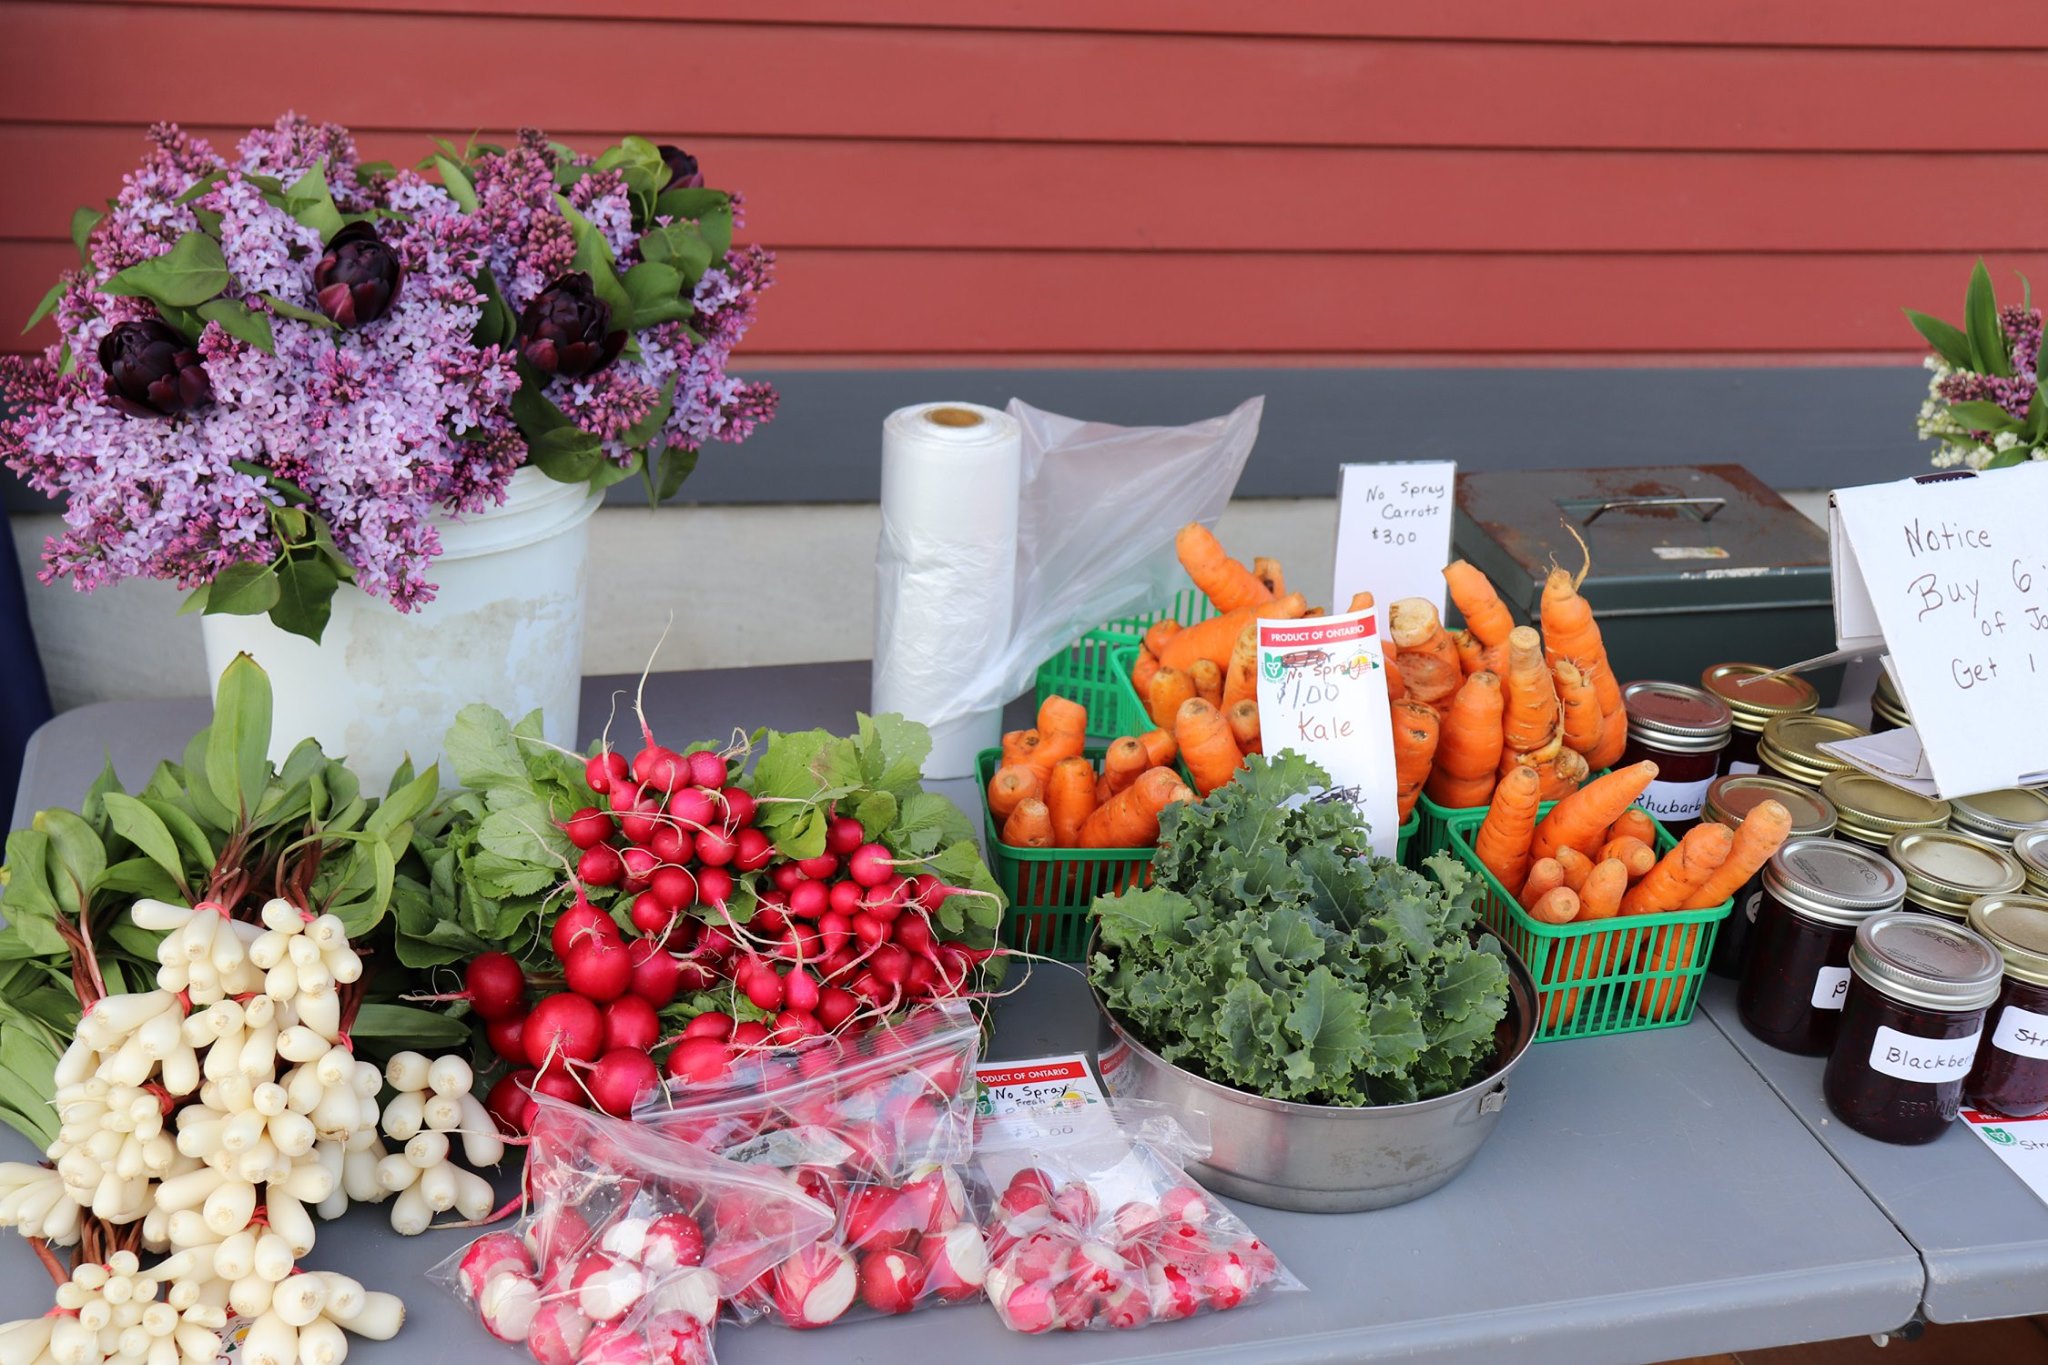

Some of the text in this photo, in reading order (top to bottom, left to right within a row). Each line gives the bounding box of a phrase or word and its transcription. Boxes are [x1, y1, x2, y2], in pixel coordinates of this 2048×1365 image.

[1366, 481, 1445, 502] No Spray
[1381, 503, 1440, 520] Carrots
[1371, 526, 1417, 546] $3.00
[1904, 517, 1992, 557] Notice
[1907, 573, 1979, 622] Buy
[2011, 559, 2032, 593] 6
[1980, 610, 2007, 636] of
[1270, 624, 1366, 643] PRODUCT OF ONTARIO
[1286, 667, 1303, 684] No
[1951, 656, 2000, 690] Get
[1298, 711, 1354, 742] Kale
[977, 1067, 1070, 1084] RODUCT OF ONTARIO
[995, 1085, 1068, 1100] No Spray
[2019, 1139, 2048, 1151] Str
